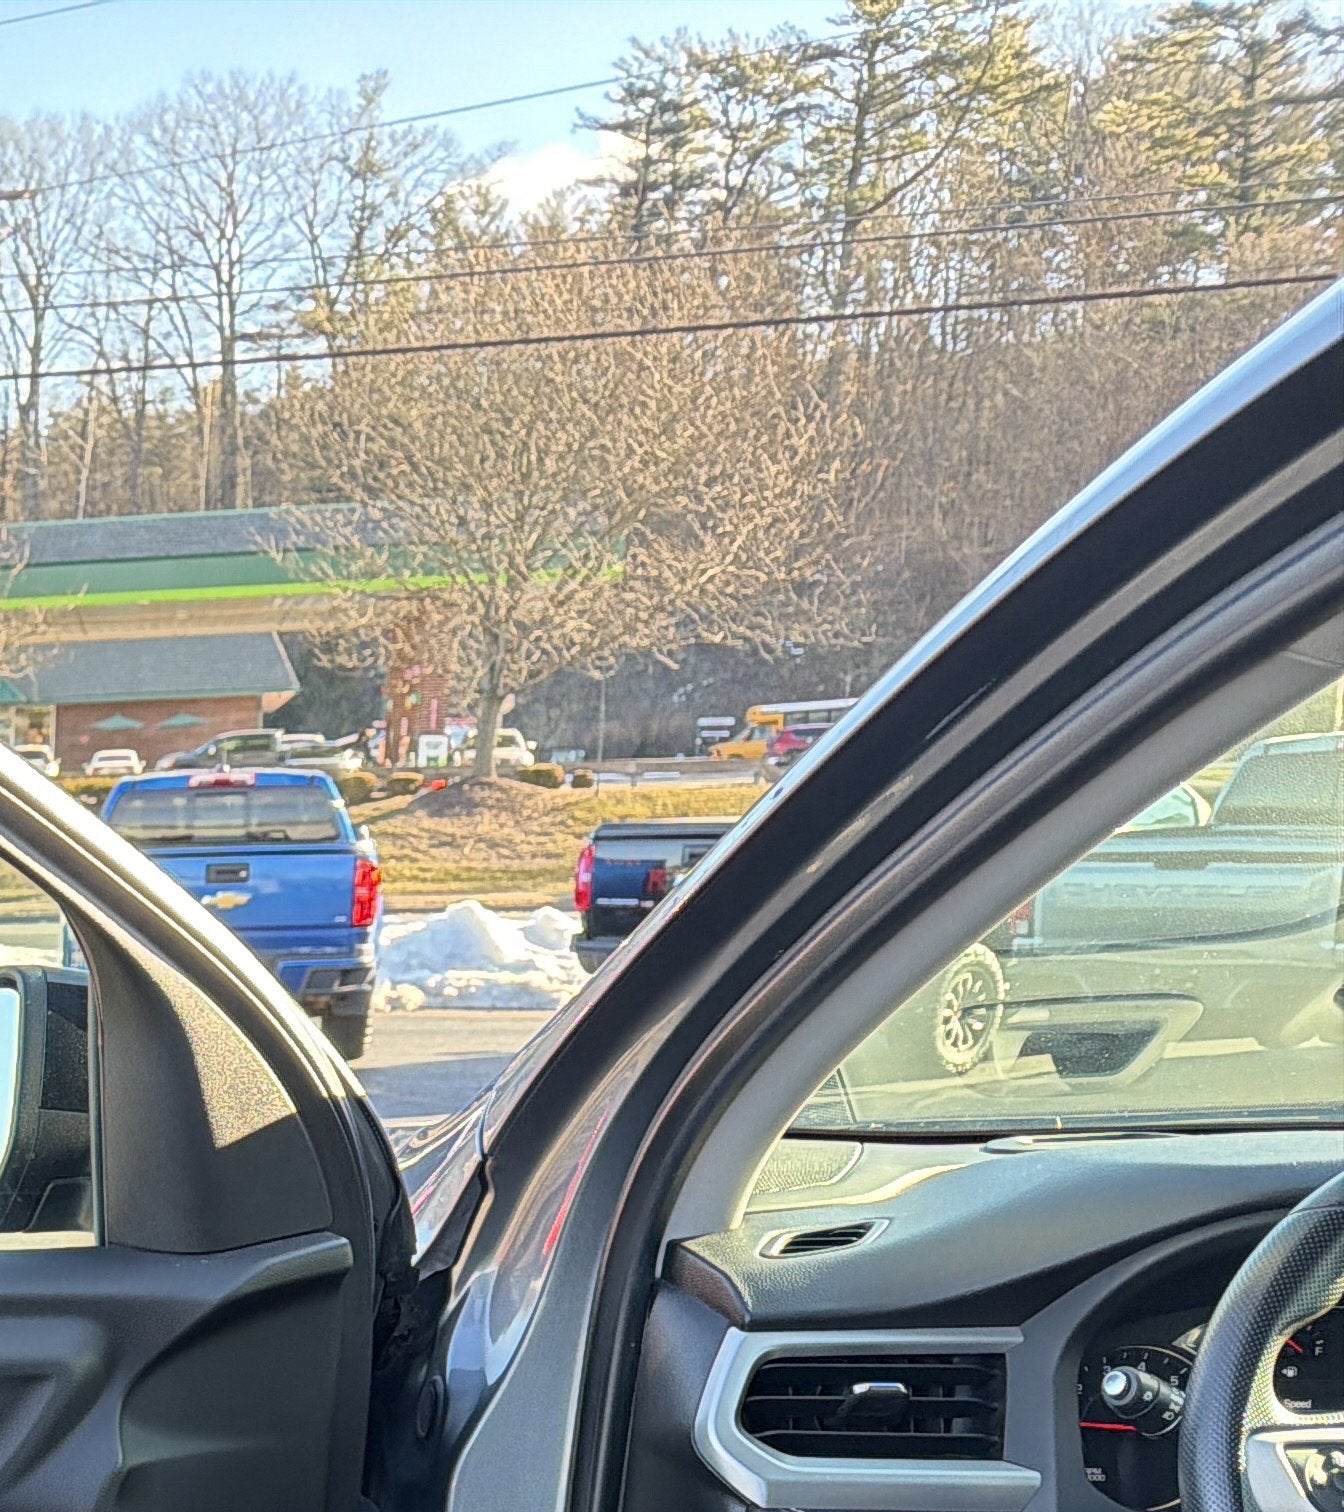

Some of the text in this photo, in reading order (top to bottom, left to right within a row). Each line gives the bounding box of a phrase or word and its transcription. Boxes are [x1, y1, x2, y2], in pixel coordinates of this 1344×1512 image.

[1138, 1361, 1146, 1372] 4
[1170, 1375, 1179, 1386] 5
[1283, 1398, 1313, 1410] Speed
